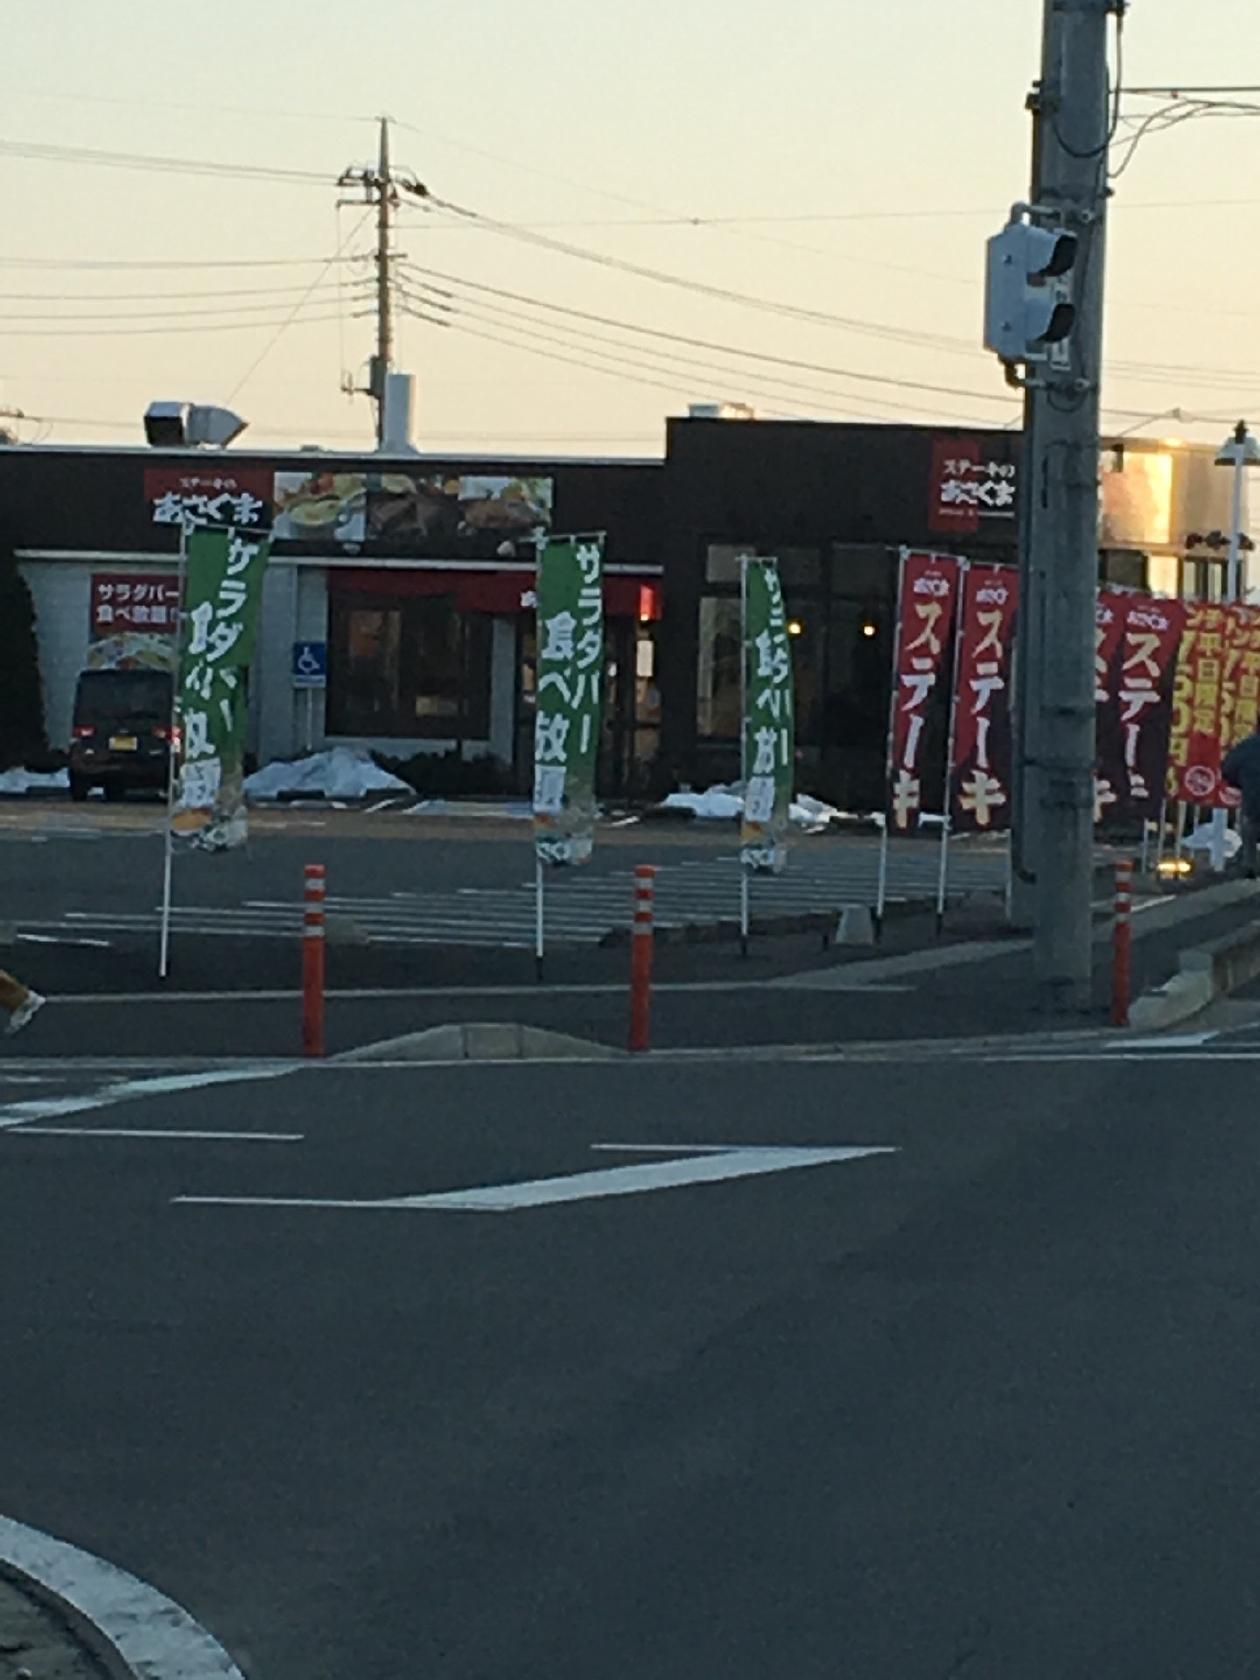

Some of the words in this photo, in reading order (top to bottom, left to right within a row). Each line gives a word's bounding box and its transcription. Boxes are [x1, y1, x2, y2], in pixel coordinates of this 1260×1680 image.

[152, 491, 264, 525] あさくま
[940, 479, 1017, 507] あさくま
[944, 459, 1016, 478] ステーキの
[570, 543, 603, 754] サラダバー
[892, 601, 943, 830] ステーキ
[957, 609, 1008, 828] ステーキ
